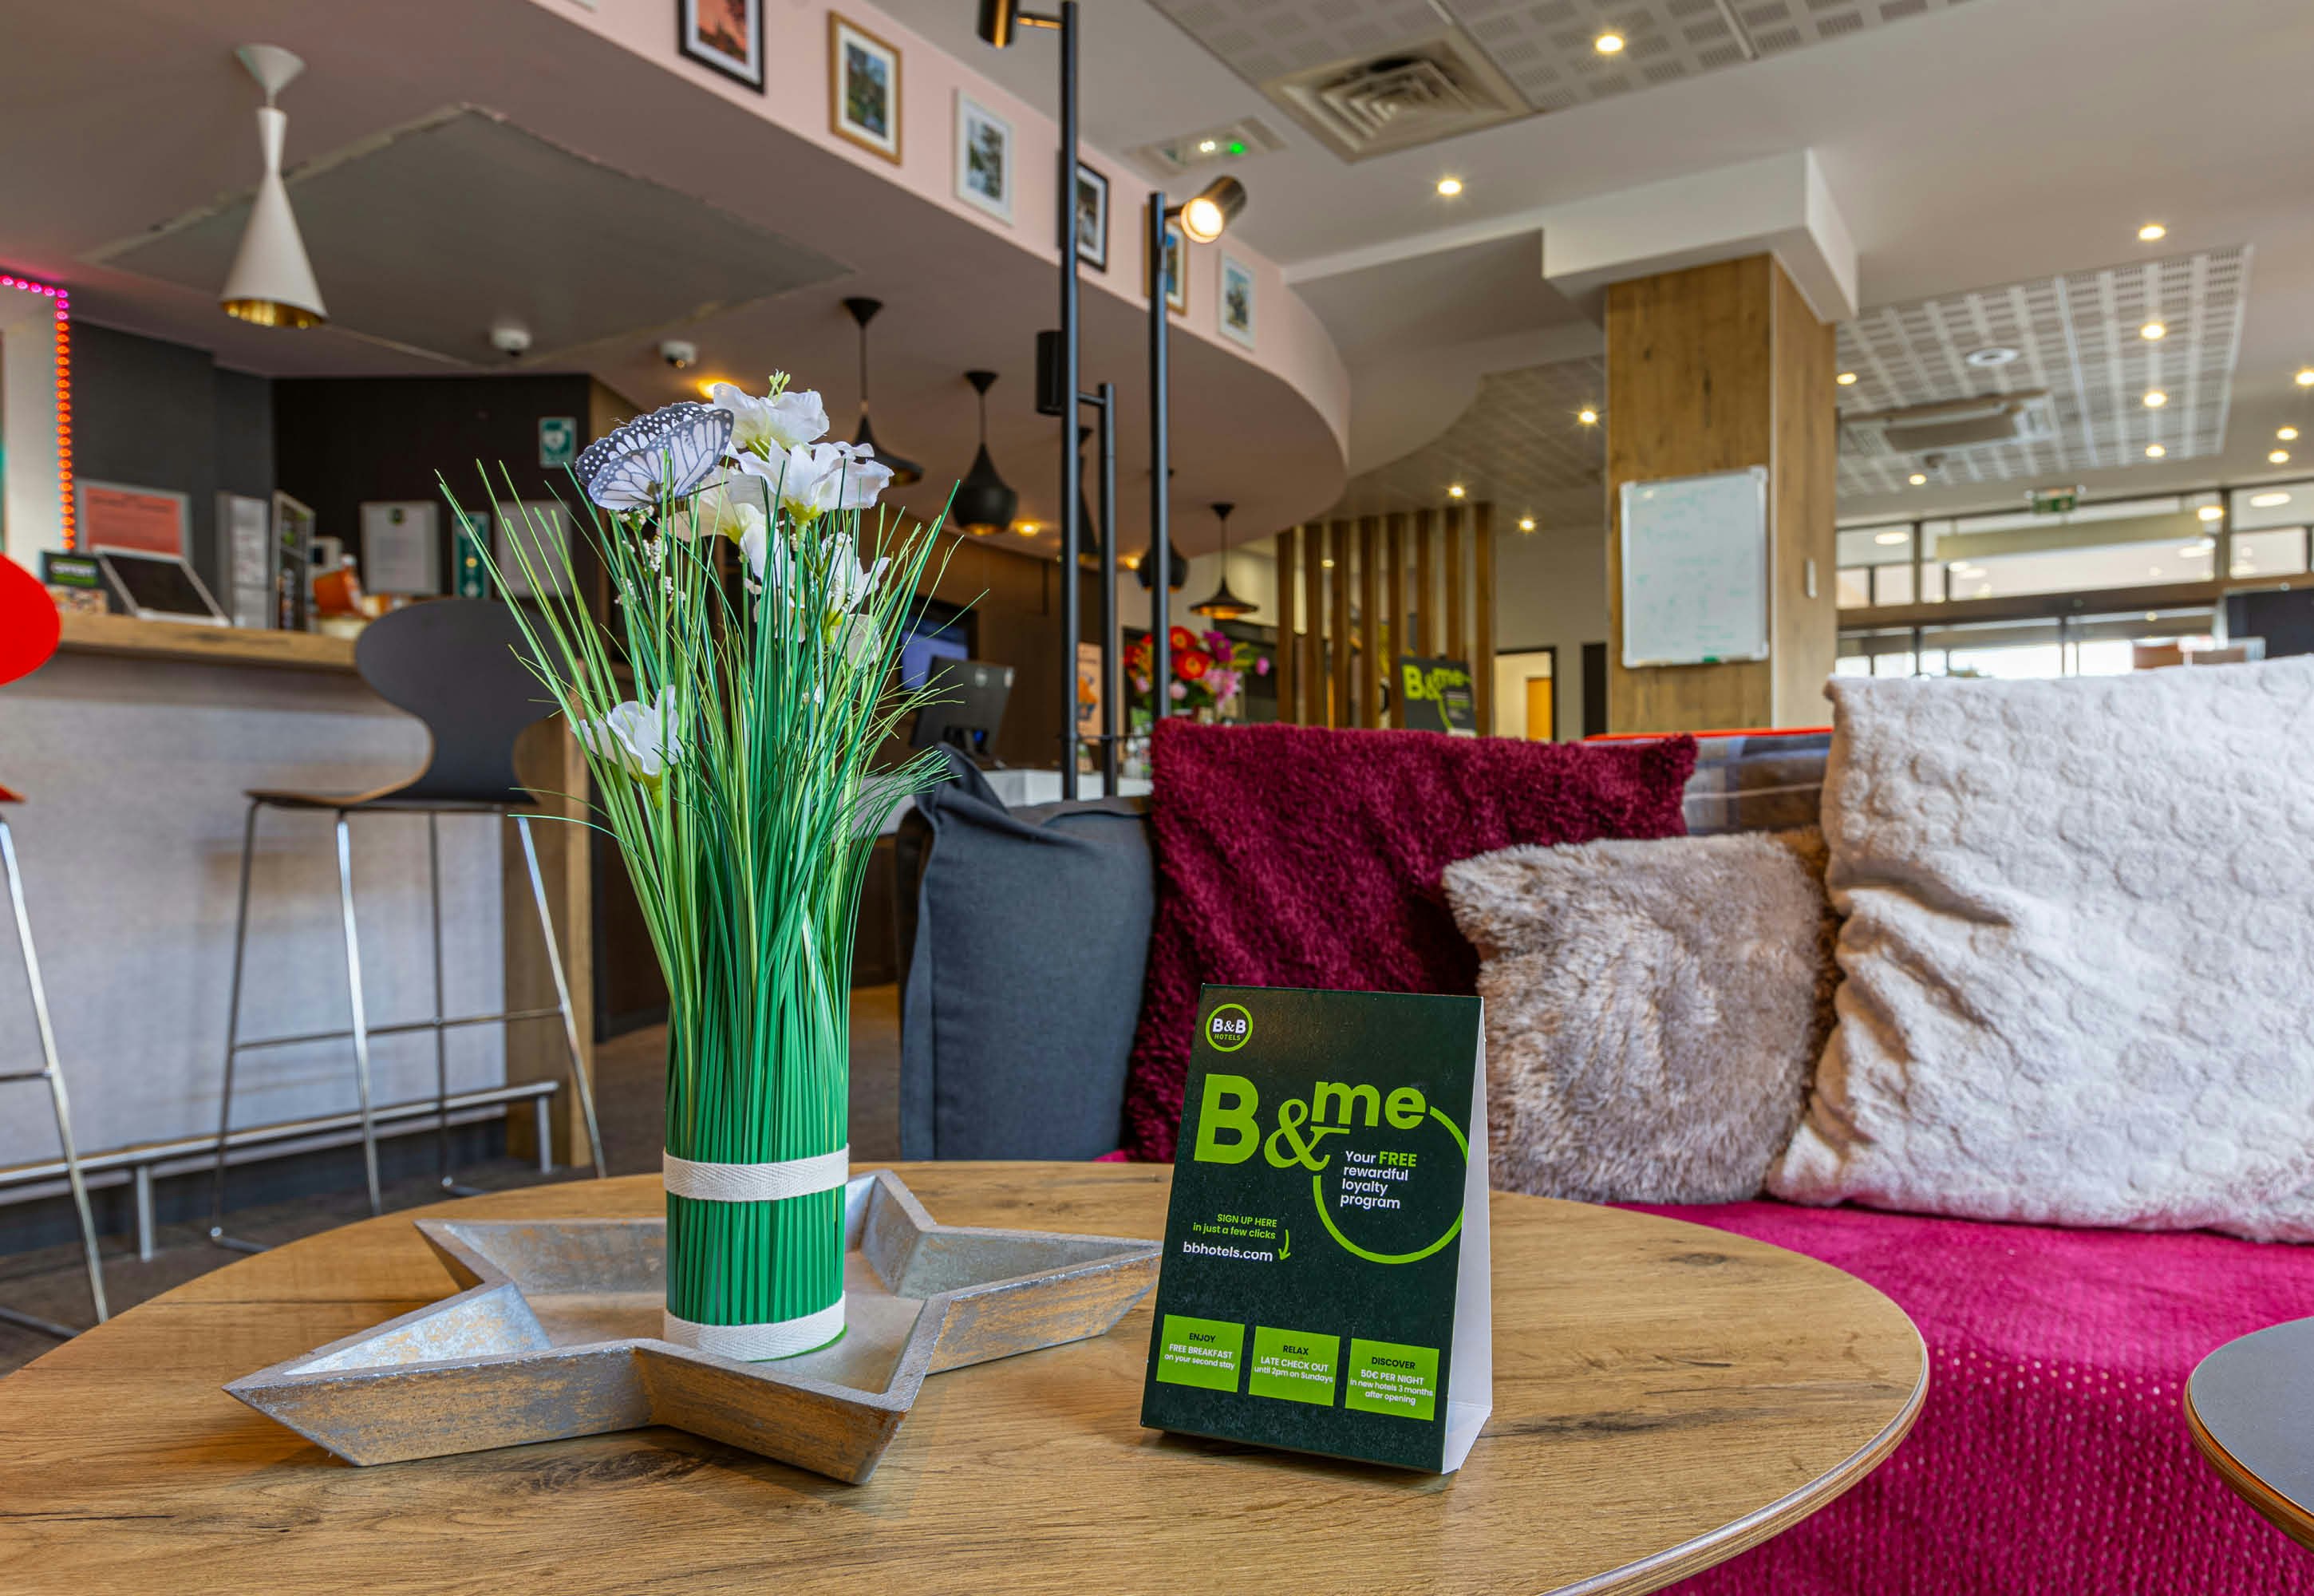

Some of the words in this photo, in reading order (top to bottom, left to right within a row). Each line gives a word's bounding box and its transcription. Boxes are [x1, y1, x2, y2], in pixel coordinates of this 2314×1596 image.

[1213, 1018, 1246, 1033] B&B
[1345, 1151, 1376, 1163] Your
[1379, 1151, 1417, 1167] FREE
[1343, 1166, 1408, 1181] rewardful
[1341, 1178, 1388, 1197] loyalty
[1341, 1194, 1400, 1210] program
[1217, 1214, 1239, 1223] SIGN
[1241, 1215, 1253, 1225] UP
[1254, 1217, 1277, 1228] HERE
[1193, 1222, 1202, 1231] in
[1202, 1223, 1221, 1235] just
[1230, 1227, 1247, 1236] few
[1249, 1229, 1276, 1239] clicks
[1183, 1241, 1273, 1262] bbhotels.com
[1189, 1333, 1216, 1343] ENJOY
[1169, 1343, 1187, 1353] FREE
[1188, 1345, 1233, 1360] BREAKFAST
[1283, 1345, 1309, 1355] RELAX
[1192, 1357, 1218, 1367] second
[1219, 1361, 1235, 1371] stay
[1261, 1356, 1280, 1366] LATE
[1281, 1359, 1309, 1370] CHECK
[1311, 1363, 1329, 1373] OUT
[1372, 1357, 1416, 1369] DISCOVER
[1271, 1367, 1288, 1377] 2pm
[1301, 1372, 1333, 1384] Sundays
[1360, 1369, 1379, 1380] 50€
[1380, 1372, 1396, 1381] PER
[1397, 1374, 1424, 1386] NIGHT
[1374, 1381, 1397, 1392] hotels
[1364, 1390, 1384, 1399] after
[1384, 1393, 1416, 1407] opening
